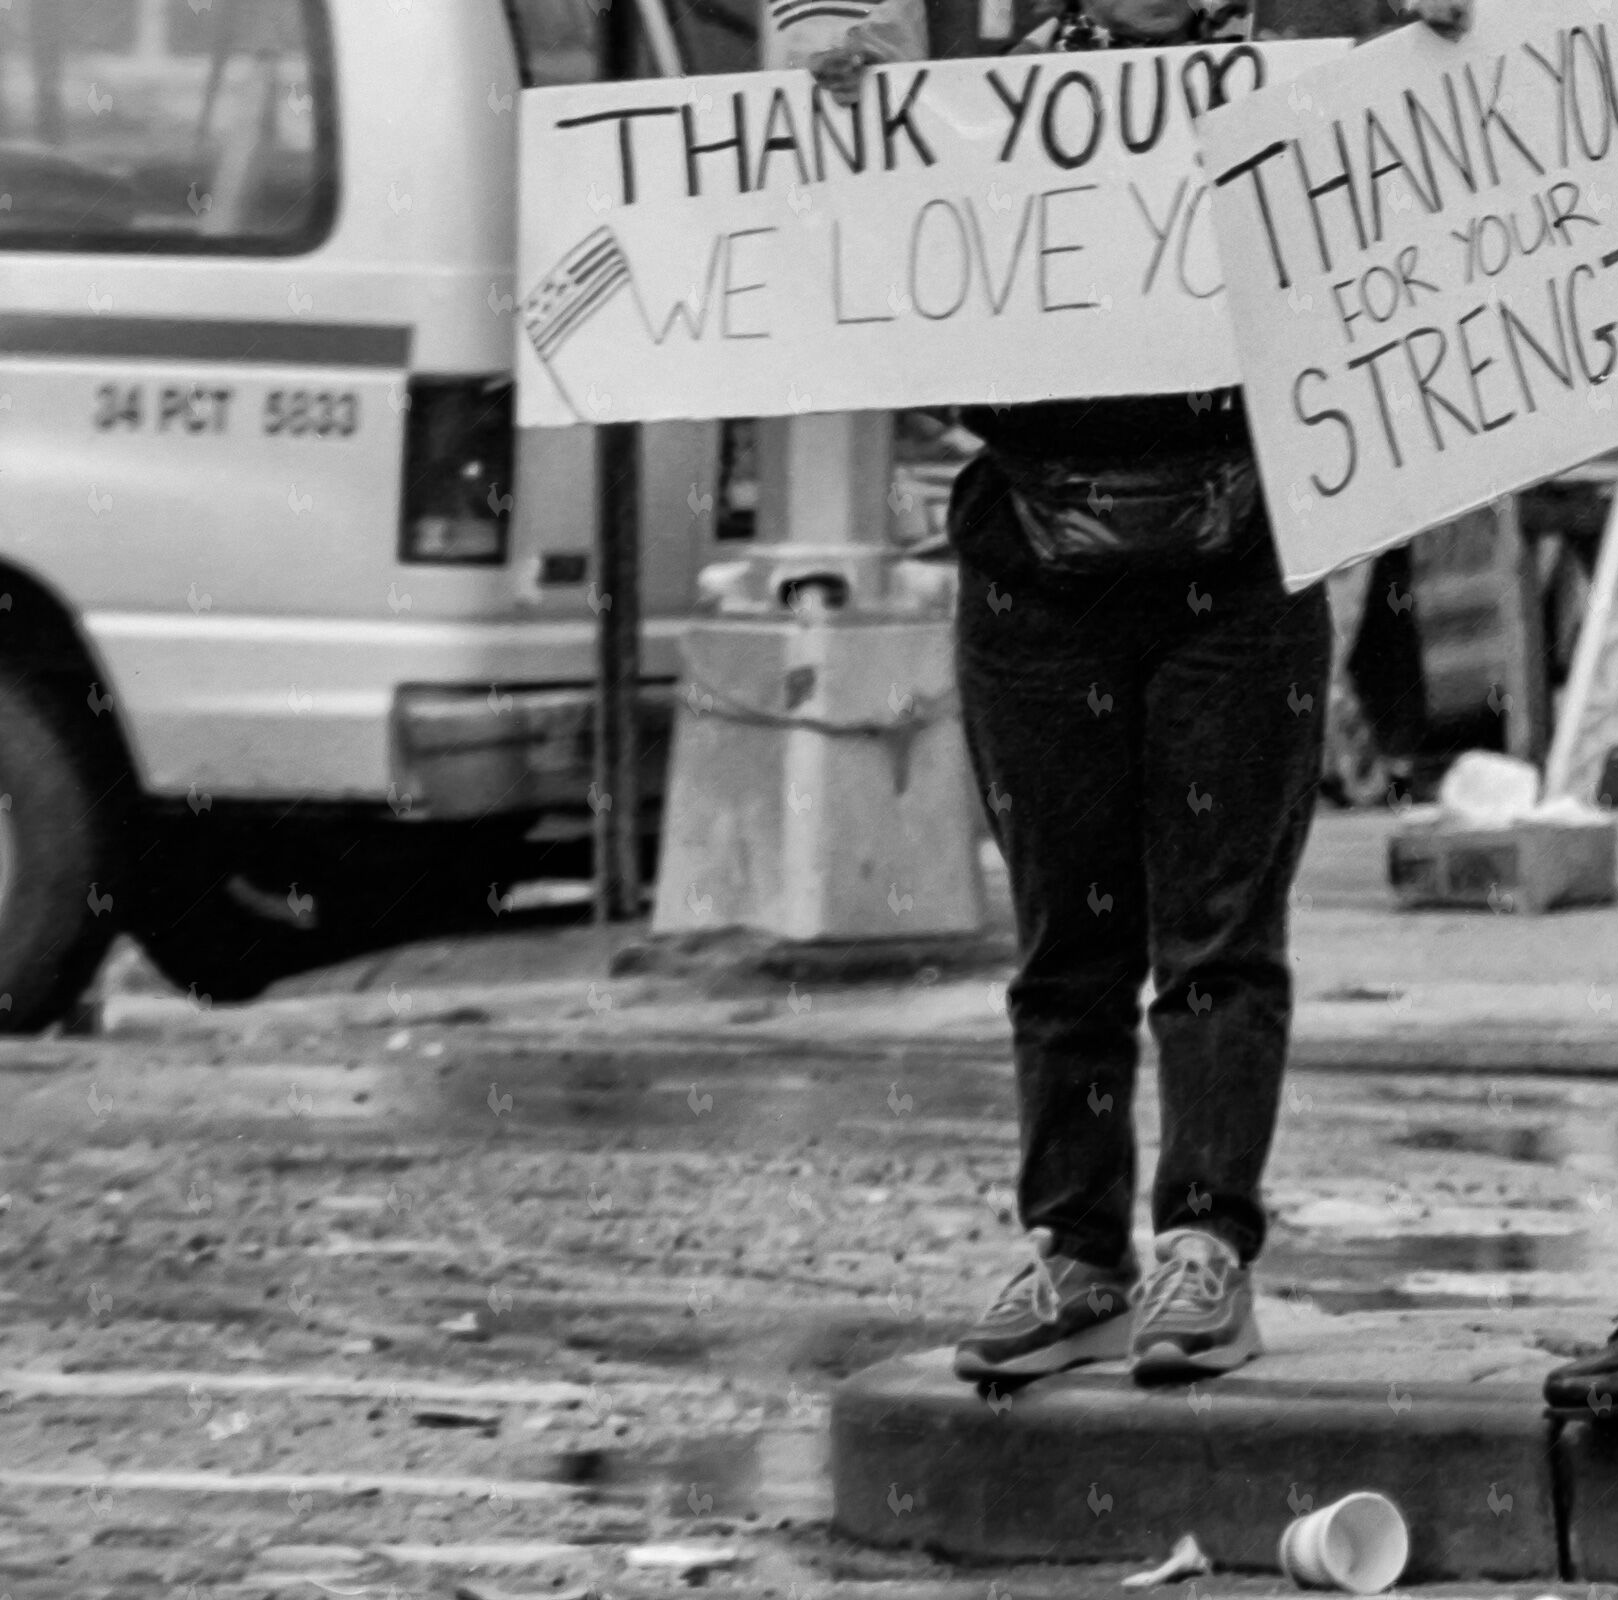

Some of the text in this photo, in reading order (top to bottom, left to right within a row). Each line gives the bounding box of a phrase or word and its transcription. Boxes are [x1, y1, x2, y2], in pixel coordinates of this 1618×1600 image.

[555, 54, 1168, 206] THANK YOU
[1214, 54, 1545, 290] THANK
[622, 224, 780, 346] WE
[830, 183, 1103, 326] LOVE
[1331, 180, 1604, 343] FOR YOUR
[158, 387, 236, 435] PCT
